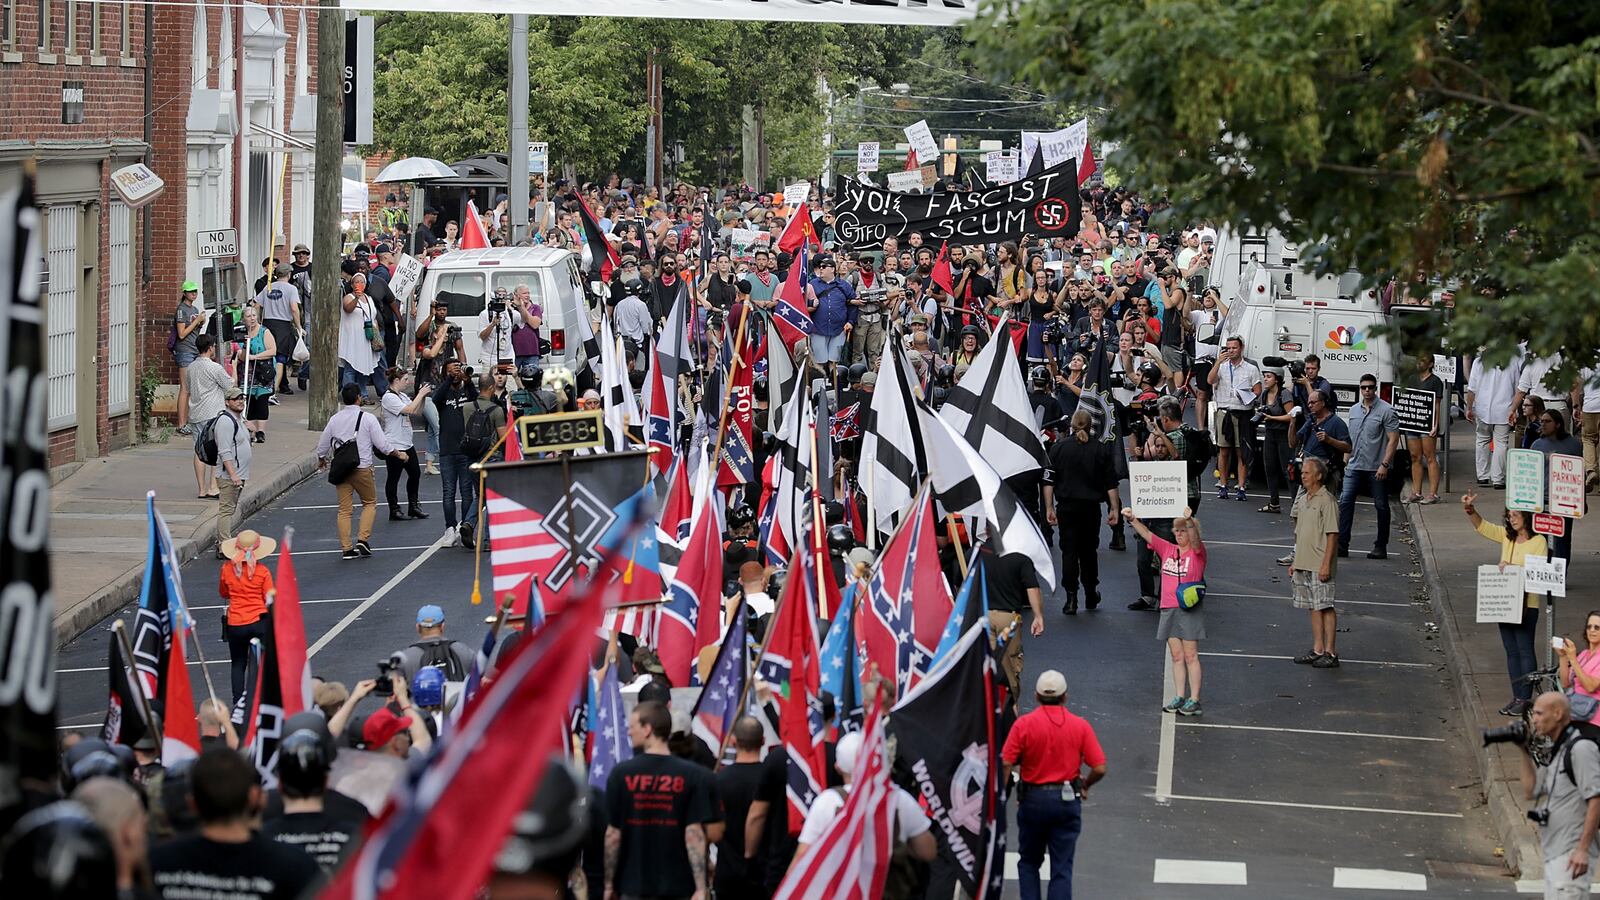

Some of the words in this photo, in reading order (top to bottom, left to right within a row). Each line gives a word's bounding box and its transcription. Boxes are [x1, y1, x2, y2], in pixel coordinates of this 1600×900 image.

[851, 189, 891, 216] YO!
[925, 173, 1059, 218] FASCIST
[841, 220, 887, 242] GTFO
[929, 208, 1026, 239] SCUM
[210, 232, 225, 242] NO
[200, 244, 235, 255] IDLING
[407, 259, 417, 271] NO
[397, 265, 416, 282] NAZIS
[1323, 353, 1342, 362] NBC
[1343, 354, 1367, 362] NEWS
[533, 421, 590, 444] 1488
[1561, 460, 1573, 471] NO
[1153, 475, 1181, 483] pretending
[1552, 472, 1581, 485] PARKING
[1151, 485, 1176, 493] Racism
[1136, 497, 1175, 506] Patriotism
[1526, 570, 1535, 581] NO
[1536, 571, 1563, 584] PARKING
[624, 774, 685, 792] VF/28
